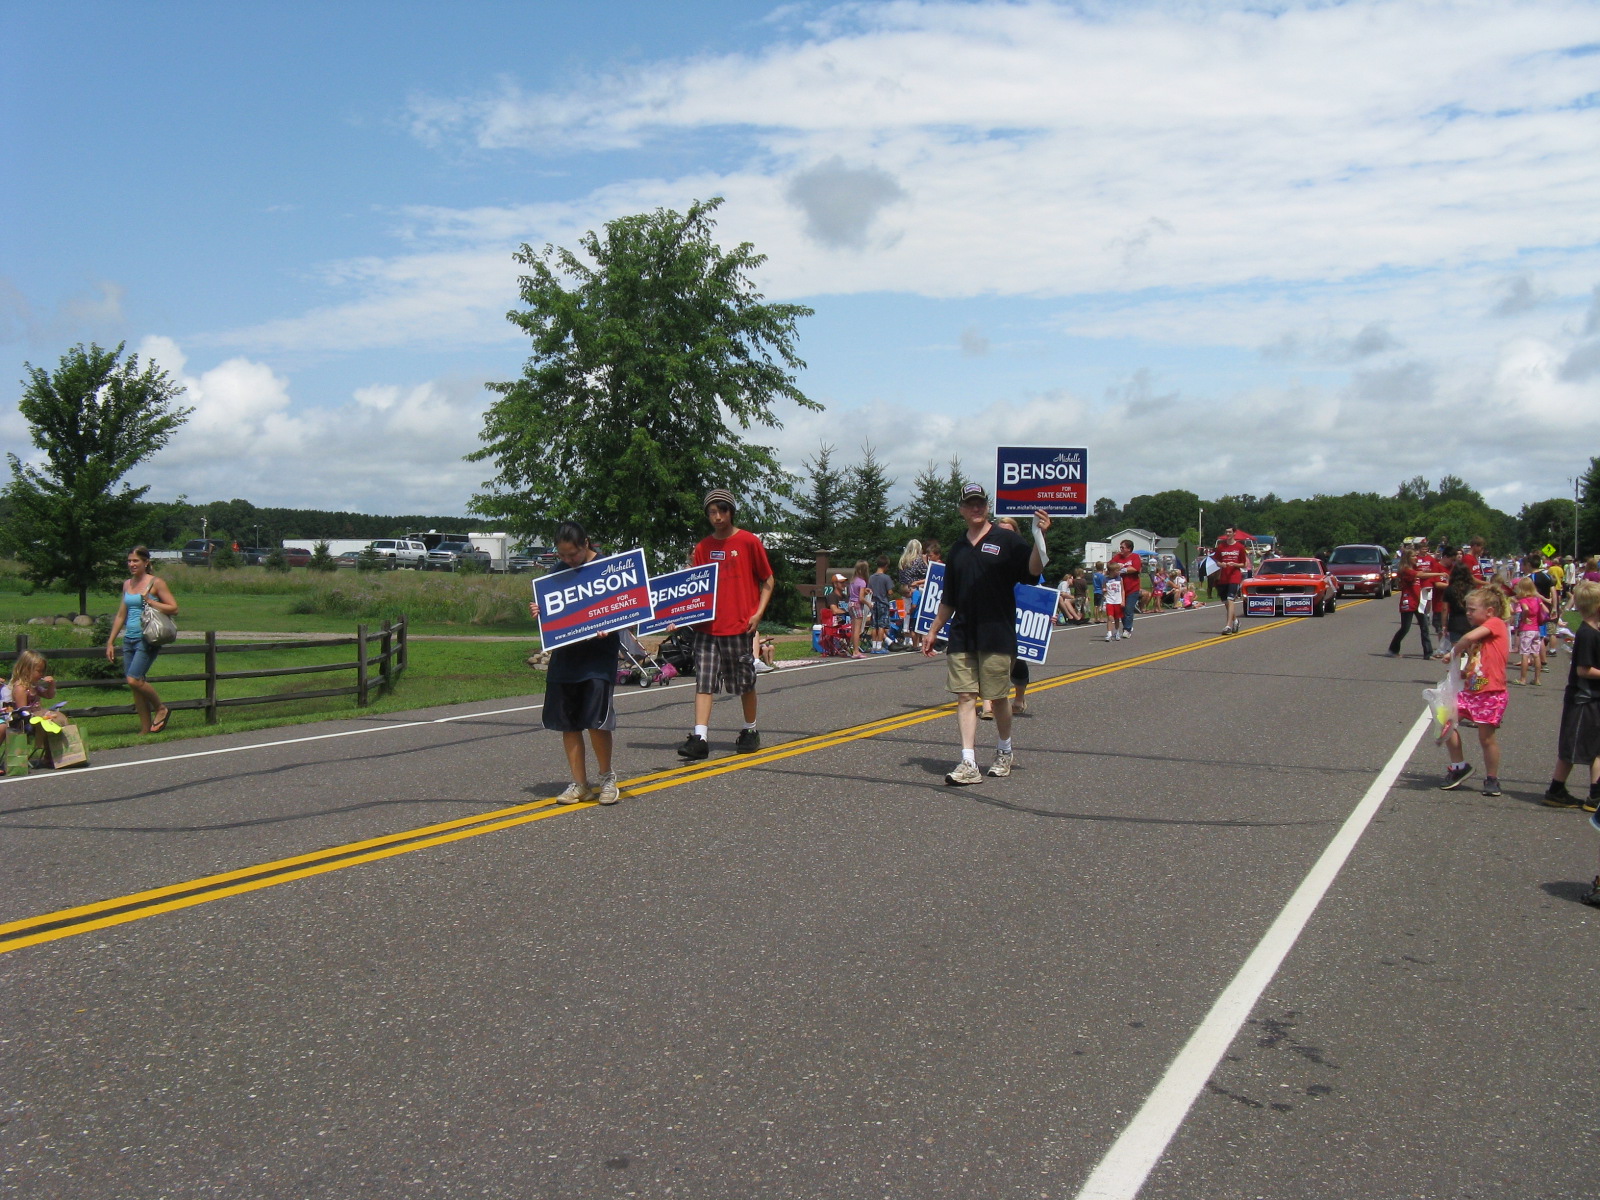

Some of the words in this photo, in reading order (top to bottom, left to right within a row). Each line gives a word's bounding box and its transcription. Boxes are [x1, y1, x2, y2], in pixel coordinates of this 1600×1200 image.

[1053, 453, 1081, 463] Michelle
[1003, 462, 1081, 485] BENSON
[1037, 491, 1055, 499] STATE
[1055, 491, 1077, 499] SENATE
[600, 558, 635, 576] Michelle
[685, 569, 710, 582] Michelle
[543, 568, 638, 616] BENSON
[616, 593, 629, 602] FOR
[650, 578, 710, 607] BENSON
[588, 604, 609, 618] STATE
[610, 597, 638, 612] SENATE
[671, 605, 686, 614] STATE
[686, 601, 706, 612] SENATE
[554, 611, 640, 641] www.michellebensonforsenate.com
